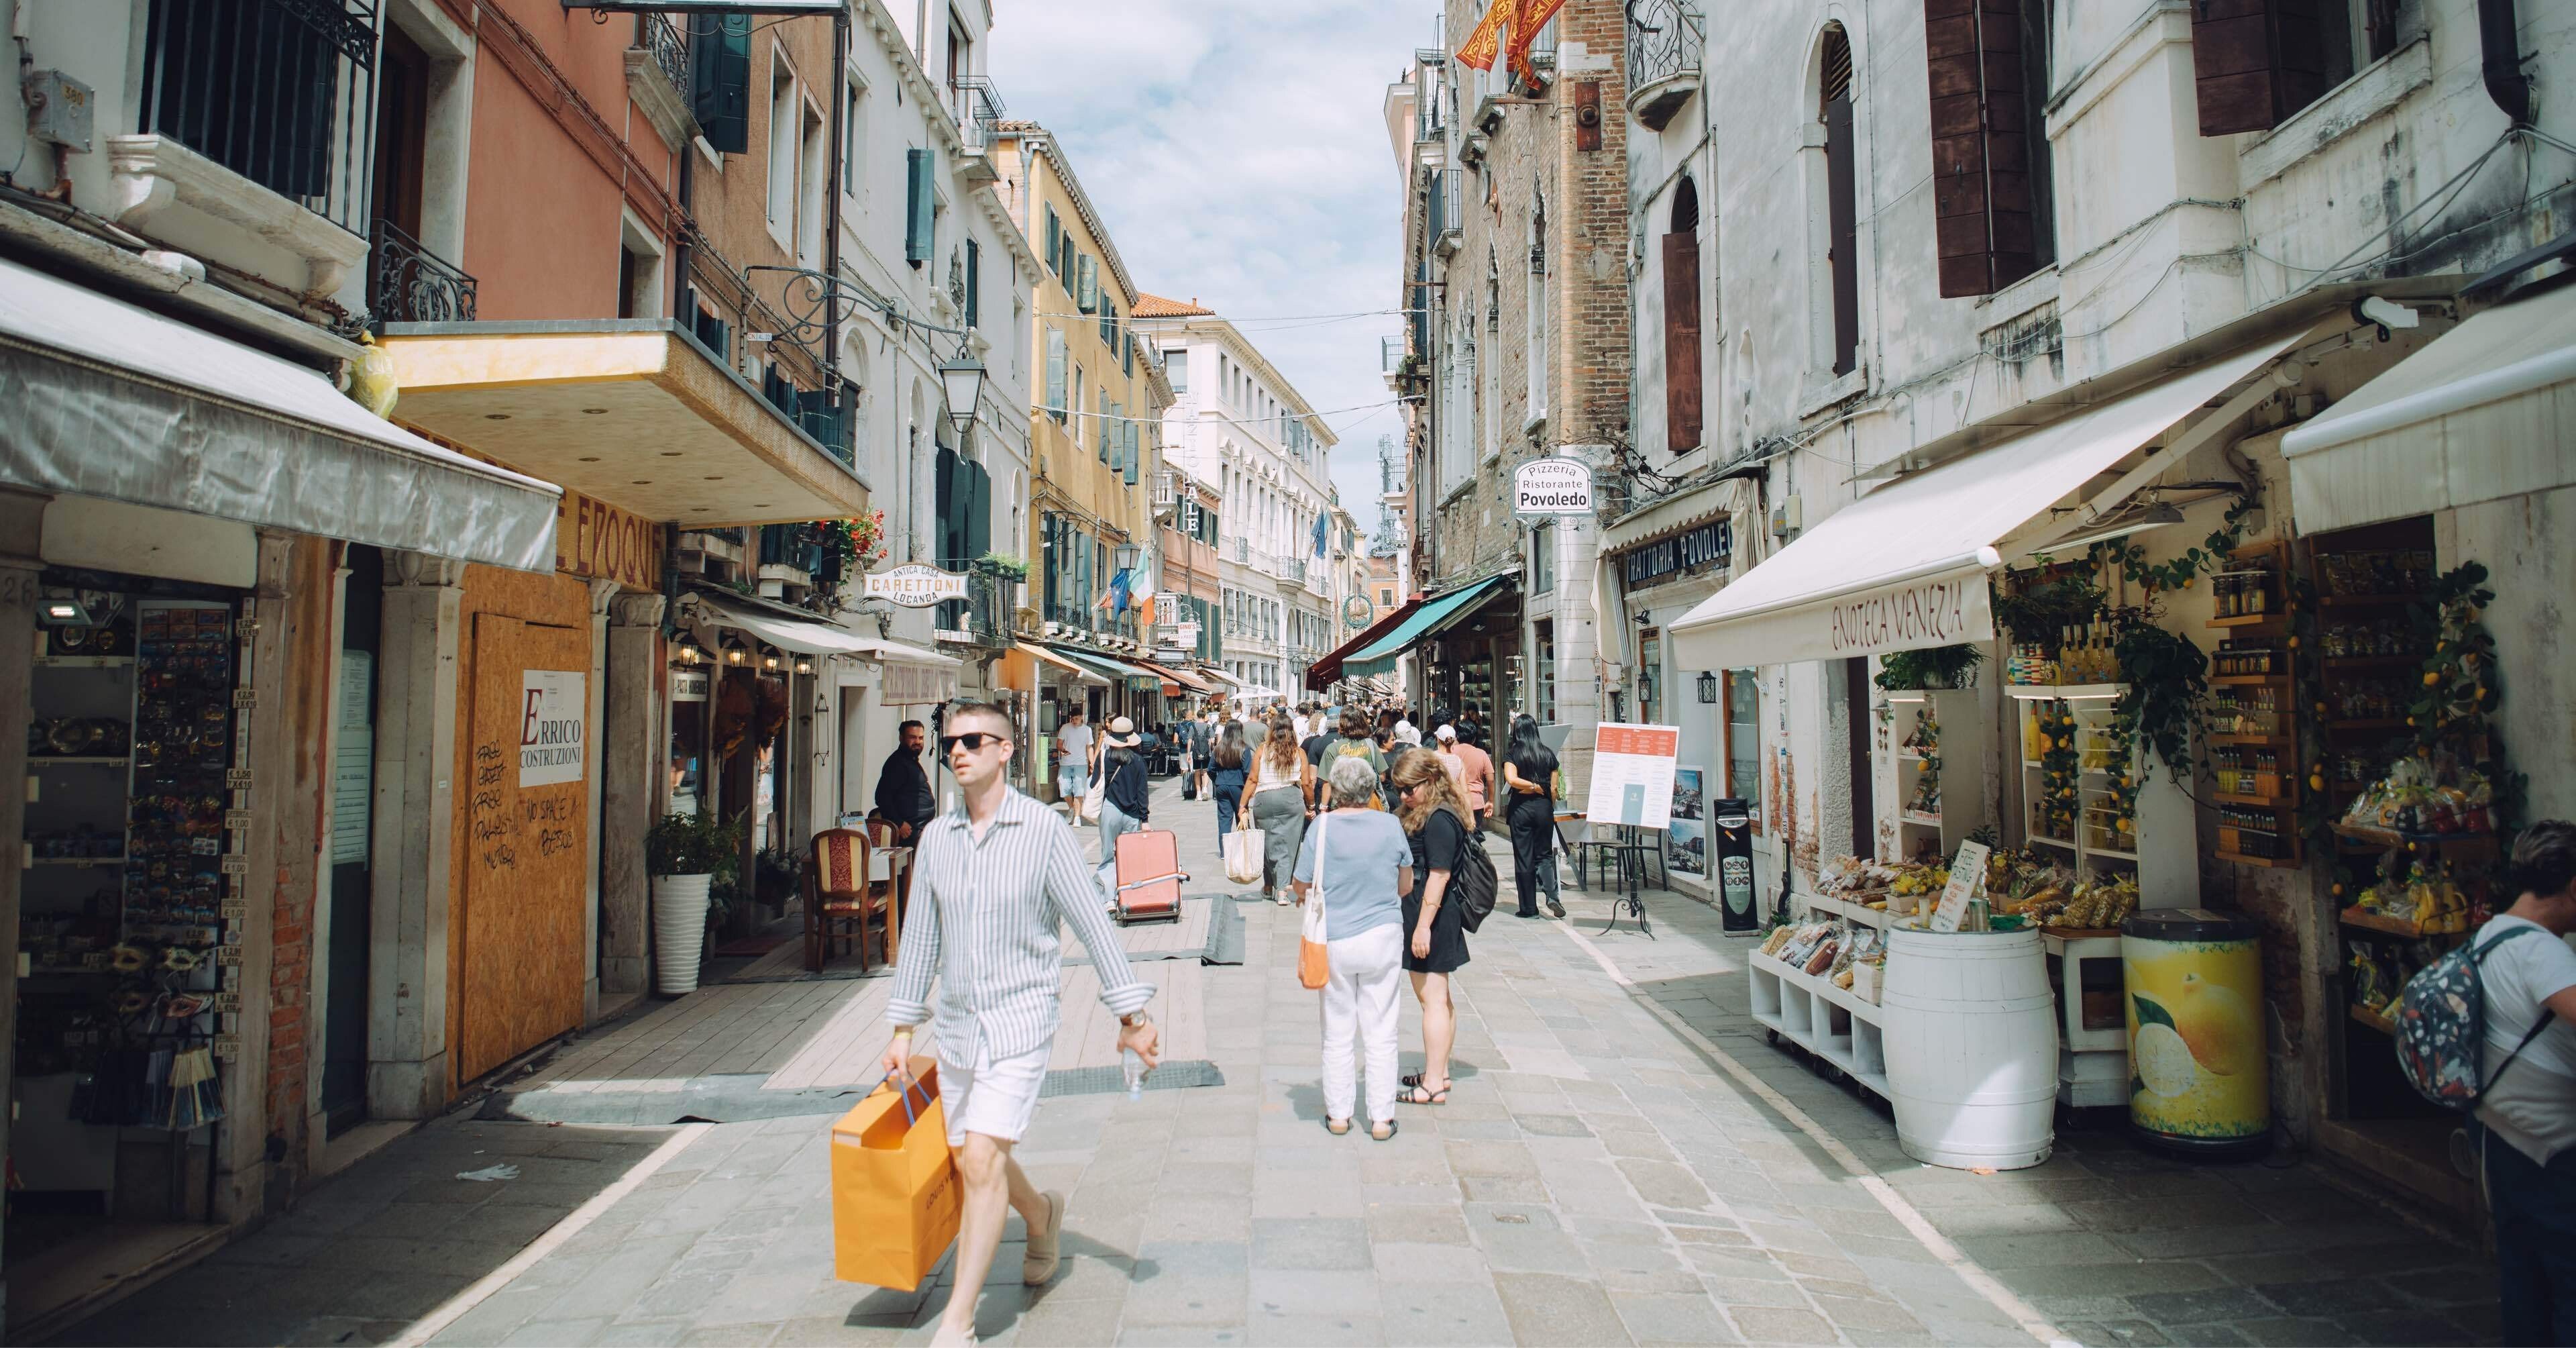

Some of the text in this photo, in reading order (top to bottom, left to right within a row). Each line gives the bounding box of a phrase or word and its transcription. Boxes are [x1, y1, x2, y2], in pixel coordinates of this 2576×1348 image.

[1528, 464, 1576, 477] Pizzeria
[1523, 479, 1582, 489] Ristorante
[1521, 492, 1587, 506] Povoledo
[1626, 540, 1674, 583] TRATTORIA
[894, 566, 939, 578] ANTICA CASA
[872, 579, 960, 592] CARETTONI
[894, 592, 938, 604] LOCANDA
[1833, 580, 1964, 651] ENOTECA VENEZIA
[521, 688, 580, 745] ERRICO
[520, 747, 580, 768] COSTRUZIONI
